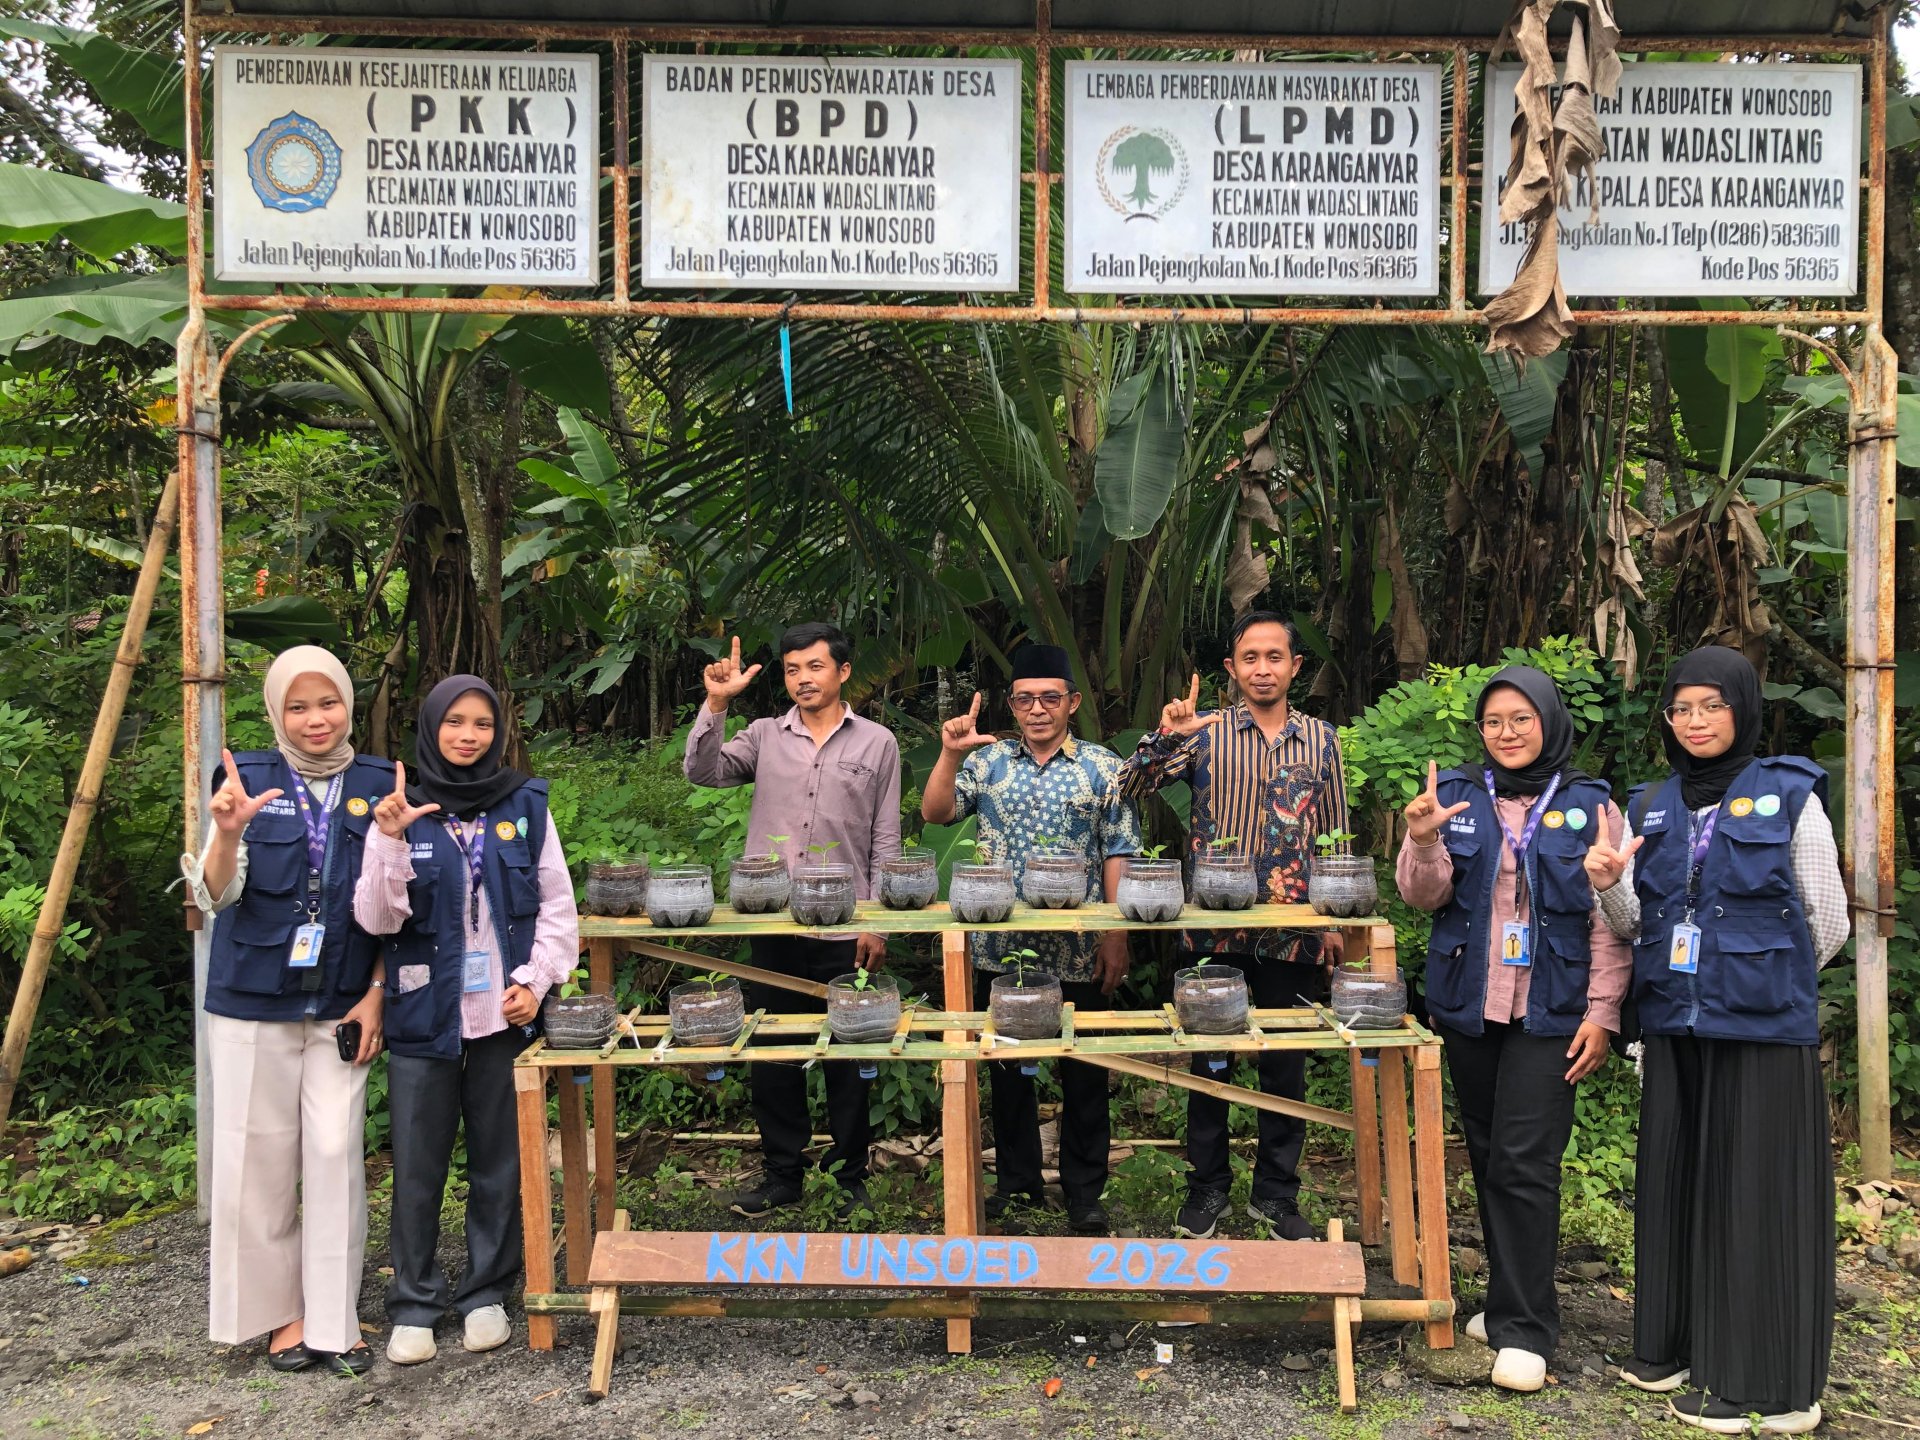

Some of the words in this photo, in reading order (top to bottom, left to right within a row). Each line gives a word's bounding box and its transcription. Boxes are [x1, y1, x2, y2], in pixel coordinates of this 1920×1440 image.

[237, 59, 352, 87] PEMBERDAYAAN
[360, 62, 491, 90] KESEJAHTERAAN
[499, 66, 577, 92] KELUARGA
[666, 67, 733, 93] BADAN
[743, 69, 933, 95] PERMUSYAWARATAN
[944, 71, 995, 96] DESA
[1087, 74, 1154, 99] LEMBAGA
[1161, 75, 1276, 100] PEMBERDAYAAN
[1284, 77, 1377, 101] MASYARAKAT
[1384, 78, 1420, 102] DESA
[1632, 87, 1732, 115] KABUPATEN
[1743, 89, 1832, 116] WONOSOBO
[367, 139, 421, 170] DESA
[428, 141, 576, 174] KARANGANYAR
[728, 144, 781, 175] DESA
[787, 145, 935, 177] KARANGANYAR
[1662, 128, 1822, 163] WADASLINTANG
[1213, 151, 1265, 182] DESA
[1272, 153, 1418, 183] KARANGANYAR
[367, 177, 456, 206] KECAMATAN
[463, 179, 576, 208] WADASLINTANG
[728, 182, 815, 209] KECAMATAN
[824, 183, 935, 211] WADASLINTANG
[1213, 188, 1300, 216] KECAMATAN
[1307, 190, 1418, 217] WADASLINTANG
[1656, 176, 1702, 208] DESA
[1712, 177, 1844, 209] KARANGANYAR
[367, 210, 471, 240] KABUPATEN
[481, 212, 576, 242] WONOSOBO
[728, 216, 830, 242] KABUPATEN
[840, 217, 935, 244] WONOSOBO
[1213, 222, 1314, 249] KABUPATEN
[1324, 223, 1418, 250] WONOSOBO
[1635, 222, 1669, 246] No.1
[1672, 222, 1707, 251] Telp
[1711, 220, 1768, 247] (0286)
[1771, 222, 1840, 247] 5836510
[238, 239, 289, 265] Jalan
[292, 240, 401, 272] Pejengkolan
[405, 244, 436, 268] No.1
[441, 245, 481, 269] Kode
[485, 246, 516, 270] Pos
[521, 247, 576, 270] 56365
[665, 247, 714, 272] Jalan
[719, 248, 827, 278] Pejengkolan
[831, 250, 861, 274] No.1
[865, 250, 906, 274] Kode
[910, 251, 939, 275] Pos
[943, 252, 998, 276] 56365
[1086, 253, 1134, 278] Jalan
[1139, 254, 1245, 283] Pejengkolan
[1249, 255, 1280, 279] No.1
[1284, 255, 1324, 279] Kode
[1328, 255, 1358, 278] Pos
[1363, 255, 1418, 279] 56365
[1702, 256, 1744, 280] Kode
[1749, 257, 1778, 280] Pos
[1784, 257, 1839, 281] 56365
[707, 1235, 806, 1283] KKN
[841, 1235, 1038, 1283] UNSOED
[1088, 1244, 1230, 1285] 2026
